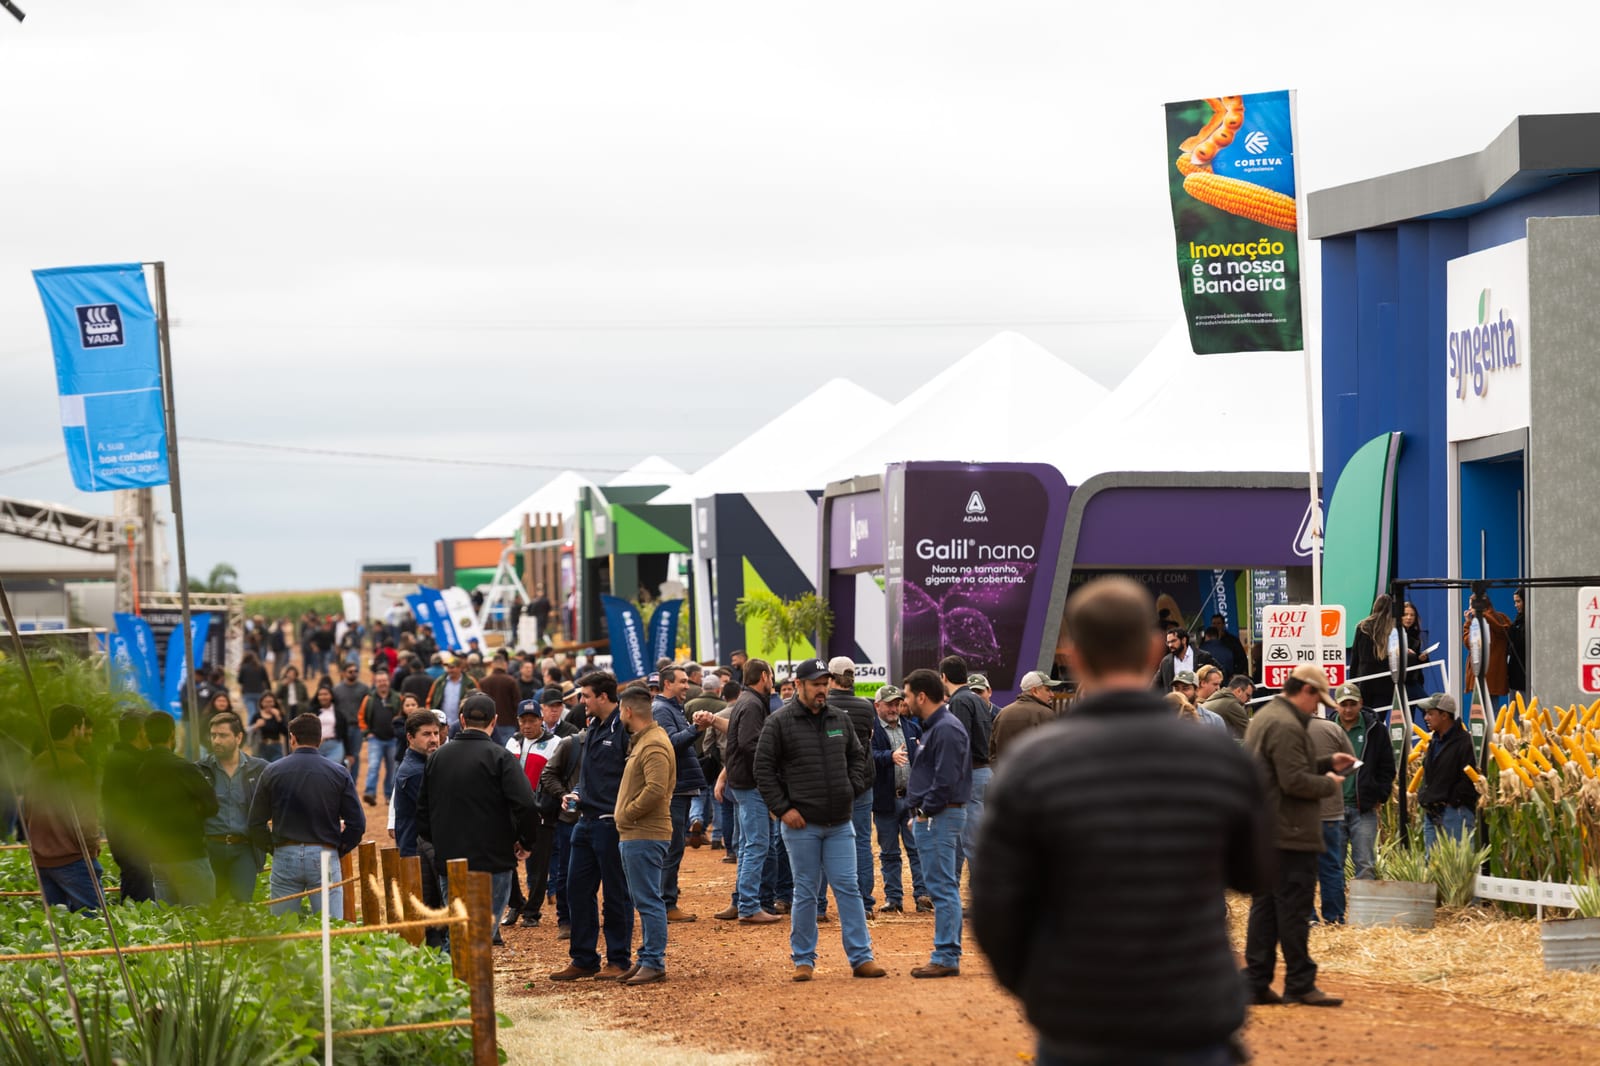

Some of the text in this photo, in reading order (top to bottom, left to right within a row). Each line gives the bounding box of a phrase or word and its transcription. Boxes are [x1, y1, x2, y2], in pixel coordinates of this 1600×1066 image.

[1234, 158, 1283, 167] CORTEVA
[1189, 237, 1285, 260] Inovação
[1191, 259, 1285, 276] é a nossa
[1192, 274, 1286, 294] Bandeira
[87, 334, 119, 345] YARA
[1449, 308, 1517, 399] syngenta
[978, 545, 1036, 559] nano
[932, 565, 1019, 576] Nano no tamanho,
[925, 576, 961, 586] gigante
[978, 575, 1026, 585] cobertura.
[1267, 611, 1307, 625] AQUI
[1270, 626, 1305, 637] TEM
[1297, 650, 1342, 661] PIOEER
